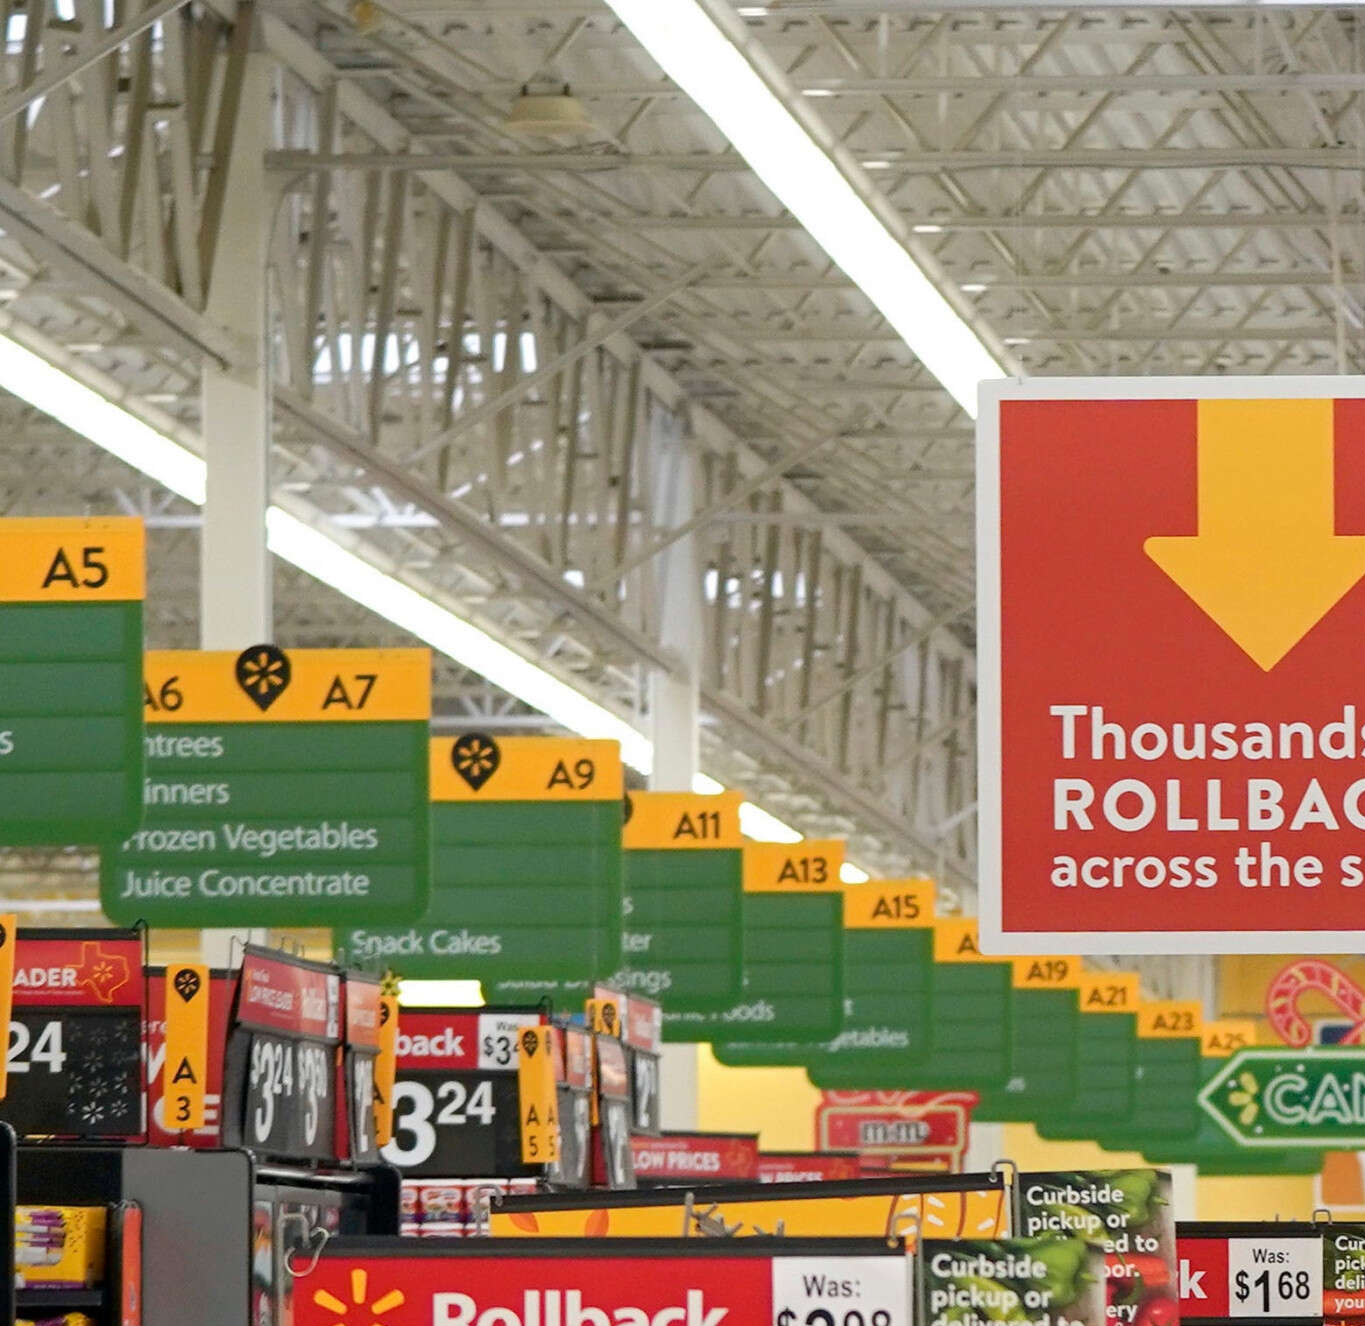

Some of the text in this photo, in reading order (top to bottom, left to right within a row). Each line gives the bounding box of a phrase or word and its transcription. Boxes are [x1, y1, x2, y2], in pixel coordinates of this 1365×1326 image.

[42, 546, 111, 589] A5
[321, 674, 379, 711] A7
[547, 759, 596, 790] A9
[673, 811, 721, 840] A11
[223, 823, 379, 858] Vegetables
[777, 858, 829, 884] A13
[1050, 852, 1218, 888] across
[1234, 841, 1323, 887] the
[121, 869, 370, 899] Juice Concentrate
[871, 895, 920, 920] A15
[351, 929, 501, 955] Snack Cakes
[1026, 961, 1069, 982] A19
[1087, 986, 1128, 1007] A21
[1151, 1012, 1194, 1032] A23
[1207, 1032, 1248, 1051] A25
[172, 1056, 198, 1084] A
[176, 1095, 191, 1122] 3
[528, 1135, 539, 1157] 5
[667, 1151, 721, 1172] PRICES
[1026, 1186, 1125, 1206] Curbside
[1027, 1212, 1131, 1238] pickup or
[1135, 1236, 1160, 1253] to
[1252, 1248, 1291, 1265] Was:
[930, 1253, 1047, 1280] Curbside
[803, 1274, 861, 1299] Was:
[1235, 1270, 1311, 1313] $168
[930, 1285, 1054, 1315] pickup or
